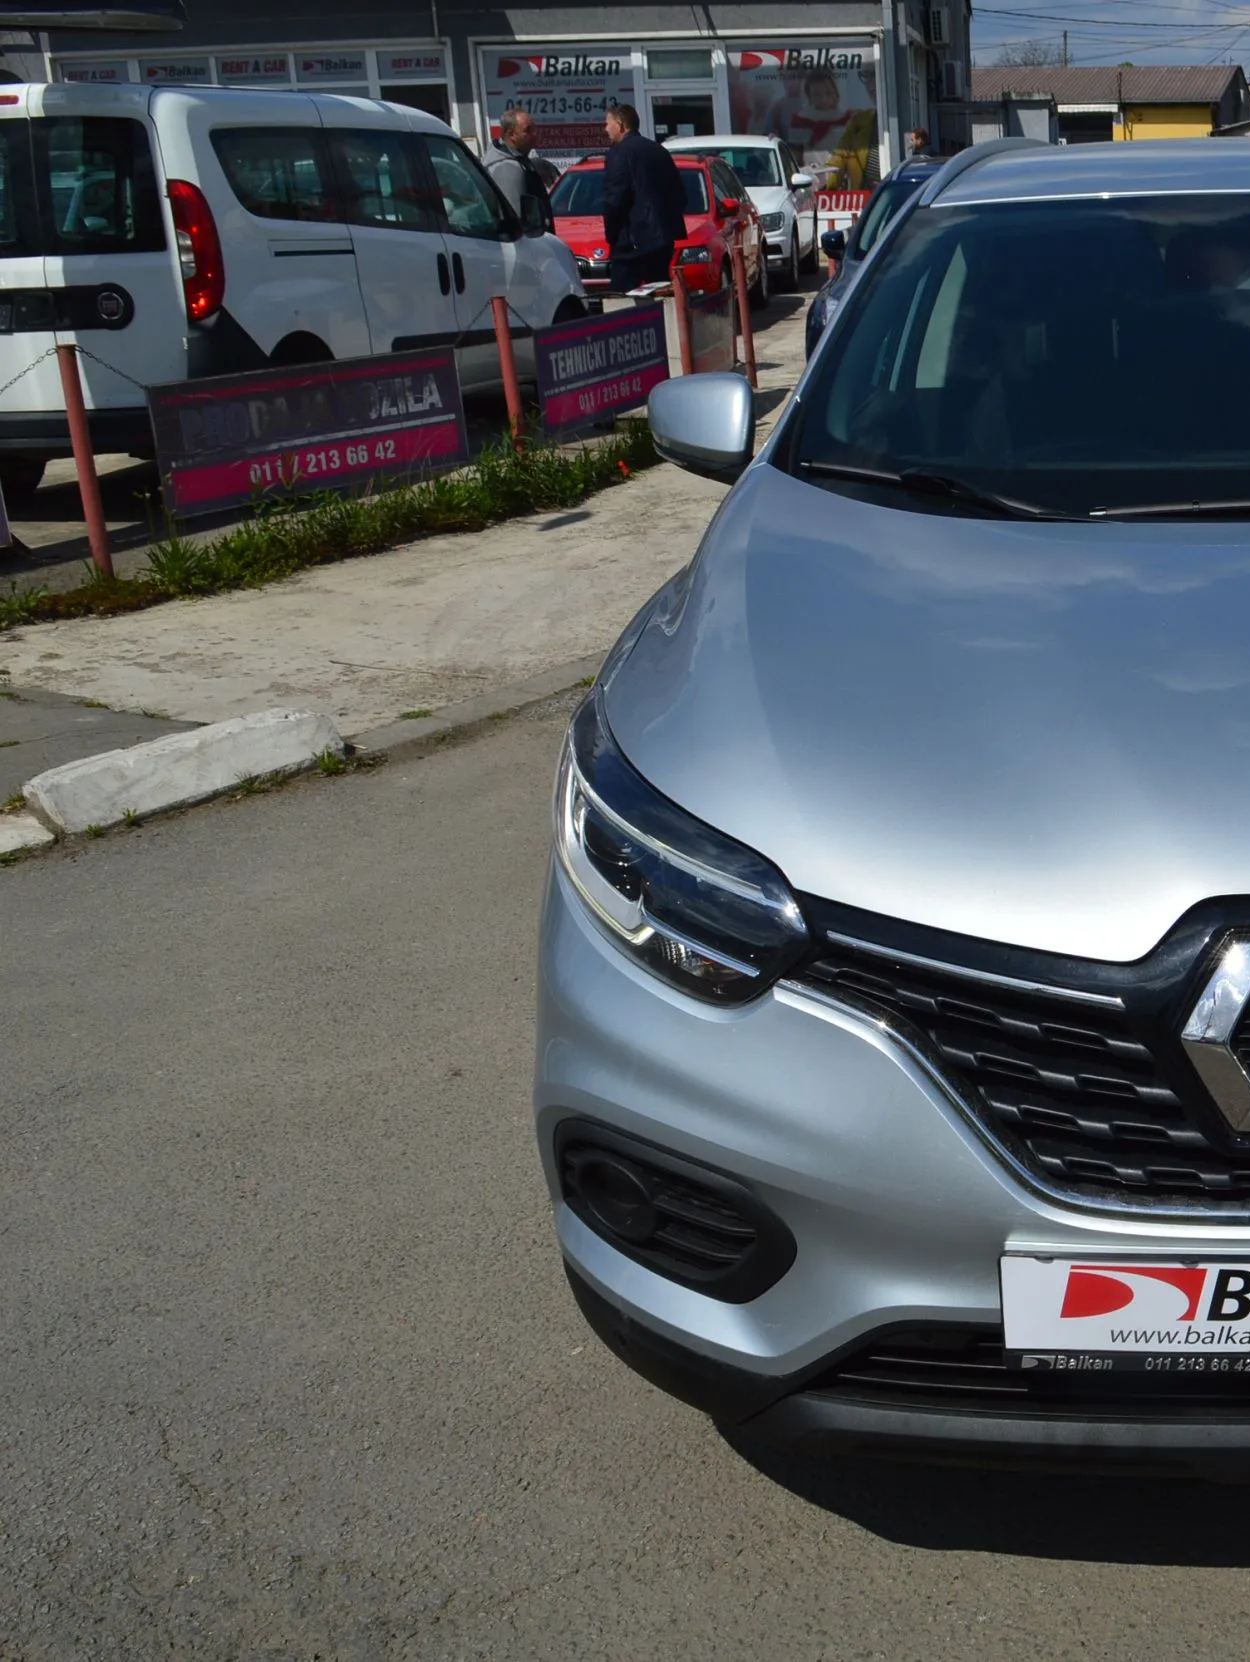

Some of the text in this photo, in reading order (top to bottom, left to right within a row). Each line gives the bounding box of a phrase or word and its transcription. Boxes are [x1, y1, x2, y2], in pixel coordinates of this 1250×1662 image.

[221, 58, 287, 75] RENT A CAR
[324, 58, 362, 71] Balkan
[390, 57, 440, 69] RENT A CAR
[544, 54, 620, 78] Balkan
[786, 48, 863, 71] Balkan
[68, 70, 89, 81] RENT
[91, 70, 98, 80] A
[168, 64, 206, 78] Balkan
[549, 327, 658, 382] TEHNIČKI PREGLED
[346, 373, 444, 424] OZILA
[579, 391, 595, 411] 011
[603, 384, 619, 402] 213
[620, 380, 631, 398] 66
[632, 376, 643, 395] 42
[250, 459, 284, 484] 011
[307, 450, 341, 474] 213
[346, 445, 369, 467] 66
[375, 439, 396, 460] 42
[1056, 1355, 1113, 1370] Balkan
[1144, 1357, 1172, 1370] 011
[1177, 1357, 1205, 1371] 213
[1210, 1358, 1230, 1371] 66
